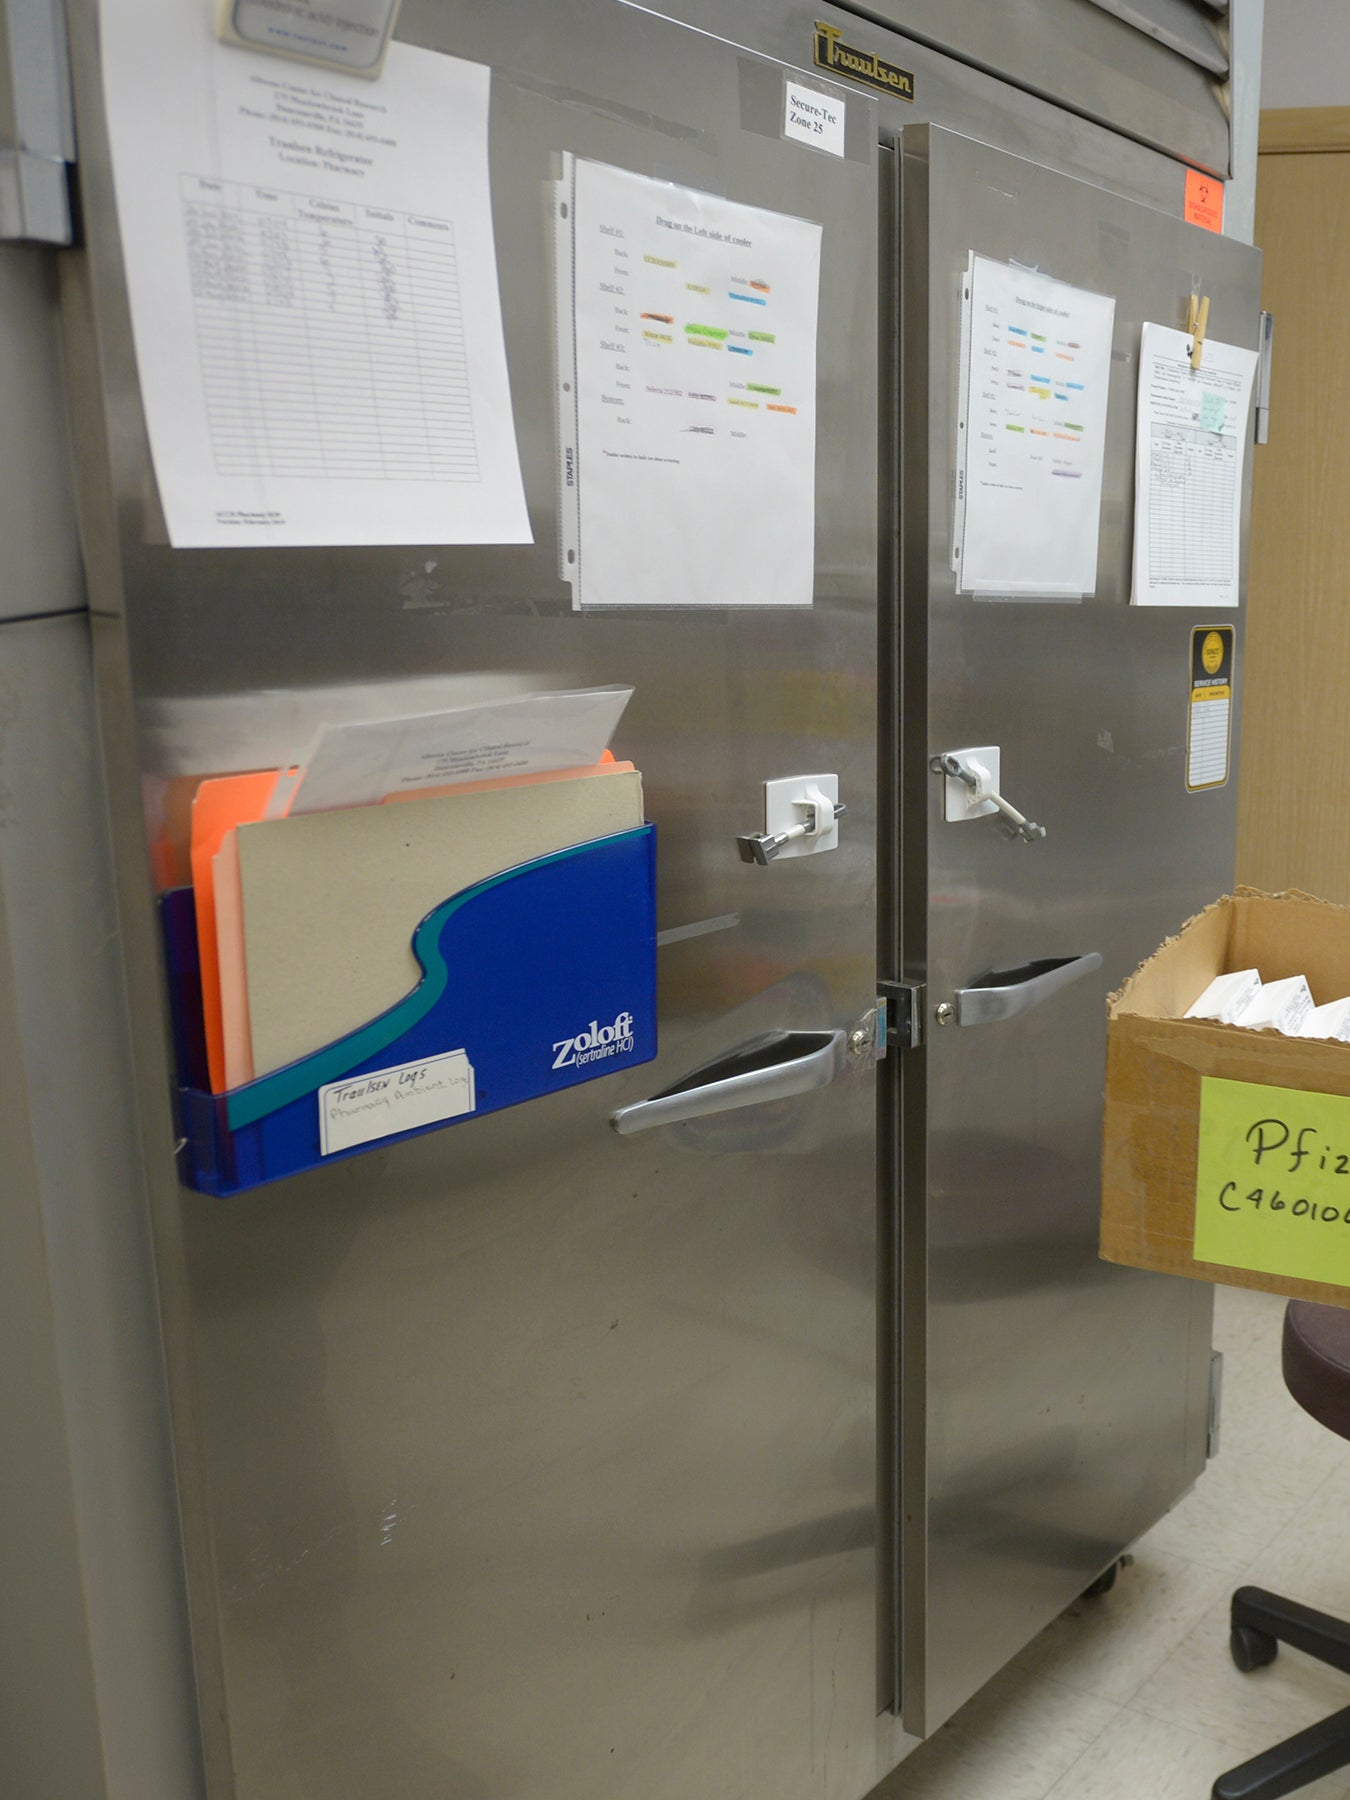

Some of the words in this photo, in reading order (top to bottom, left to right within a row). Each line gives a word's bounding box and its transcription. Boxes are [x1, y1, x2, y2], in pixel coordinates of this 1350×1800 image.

[814, 20, 912, 93] Traulsen
[790, 94, 836, 125] Secure-Tec
[790, 111, 811, 130] Zone
[813, 121, 823, 134] 25
[656, 215, 673, 229] Drug
[674, 222, 682, 231] on
[683, 223, 693, 233] the
[694, 226, 708, 237] Left
[709, 231, 723, 241] side
[724, 234, 732, 243] of
[732, 237, 752, 249] cooler
[566, 447, 574, 486] STAPLES
[552, 1012, 634, 1070] Zoloft
[576, 1044, 615, 1069] (sertraline
[398, 1067, 428, 1088] Logs
